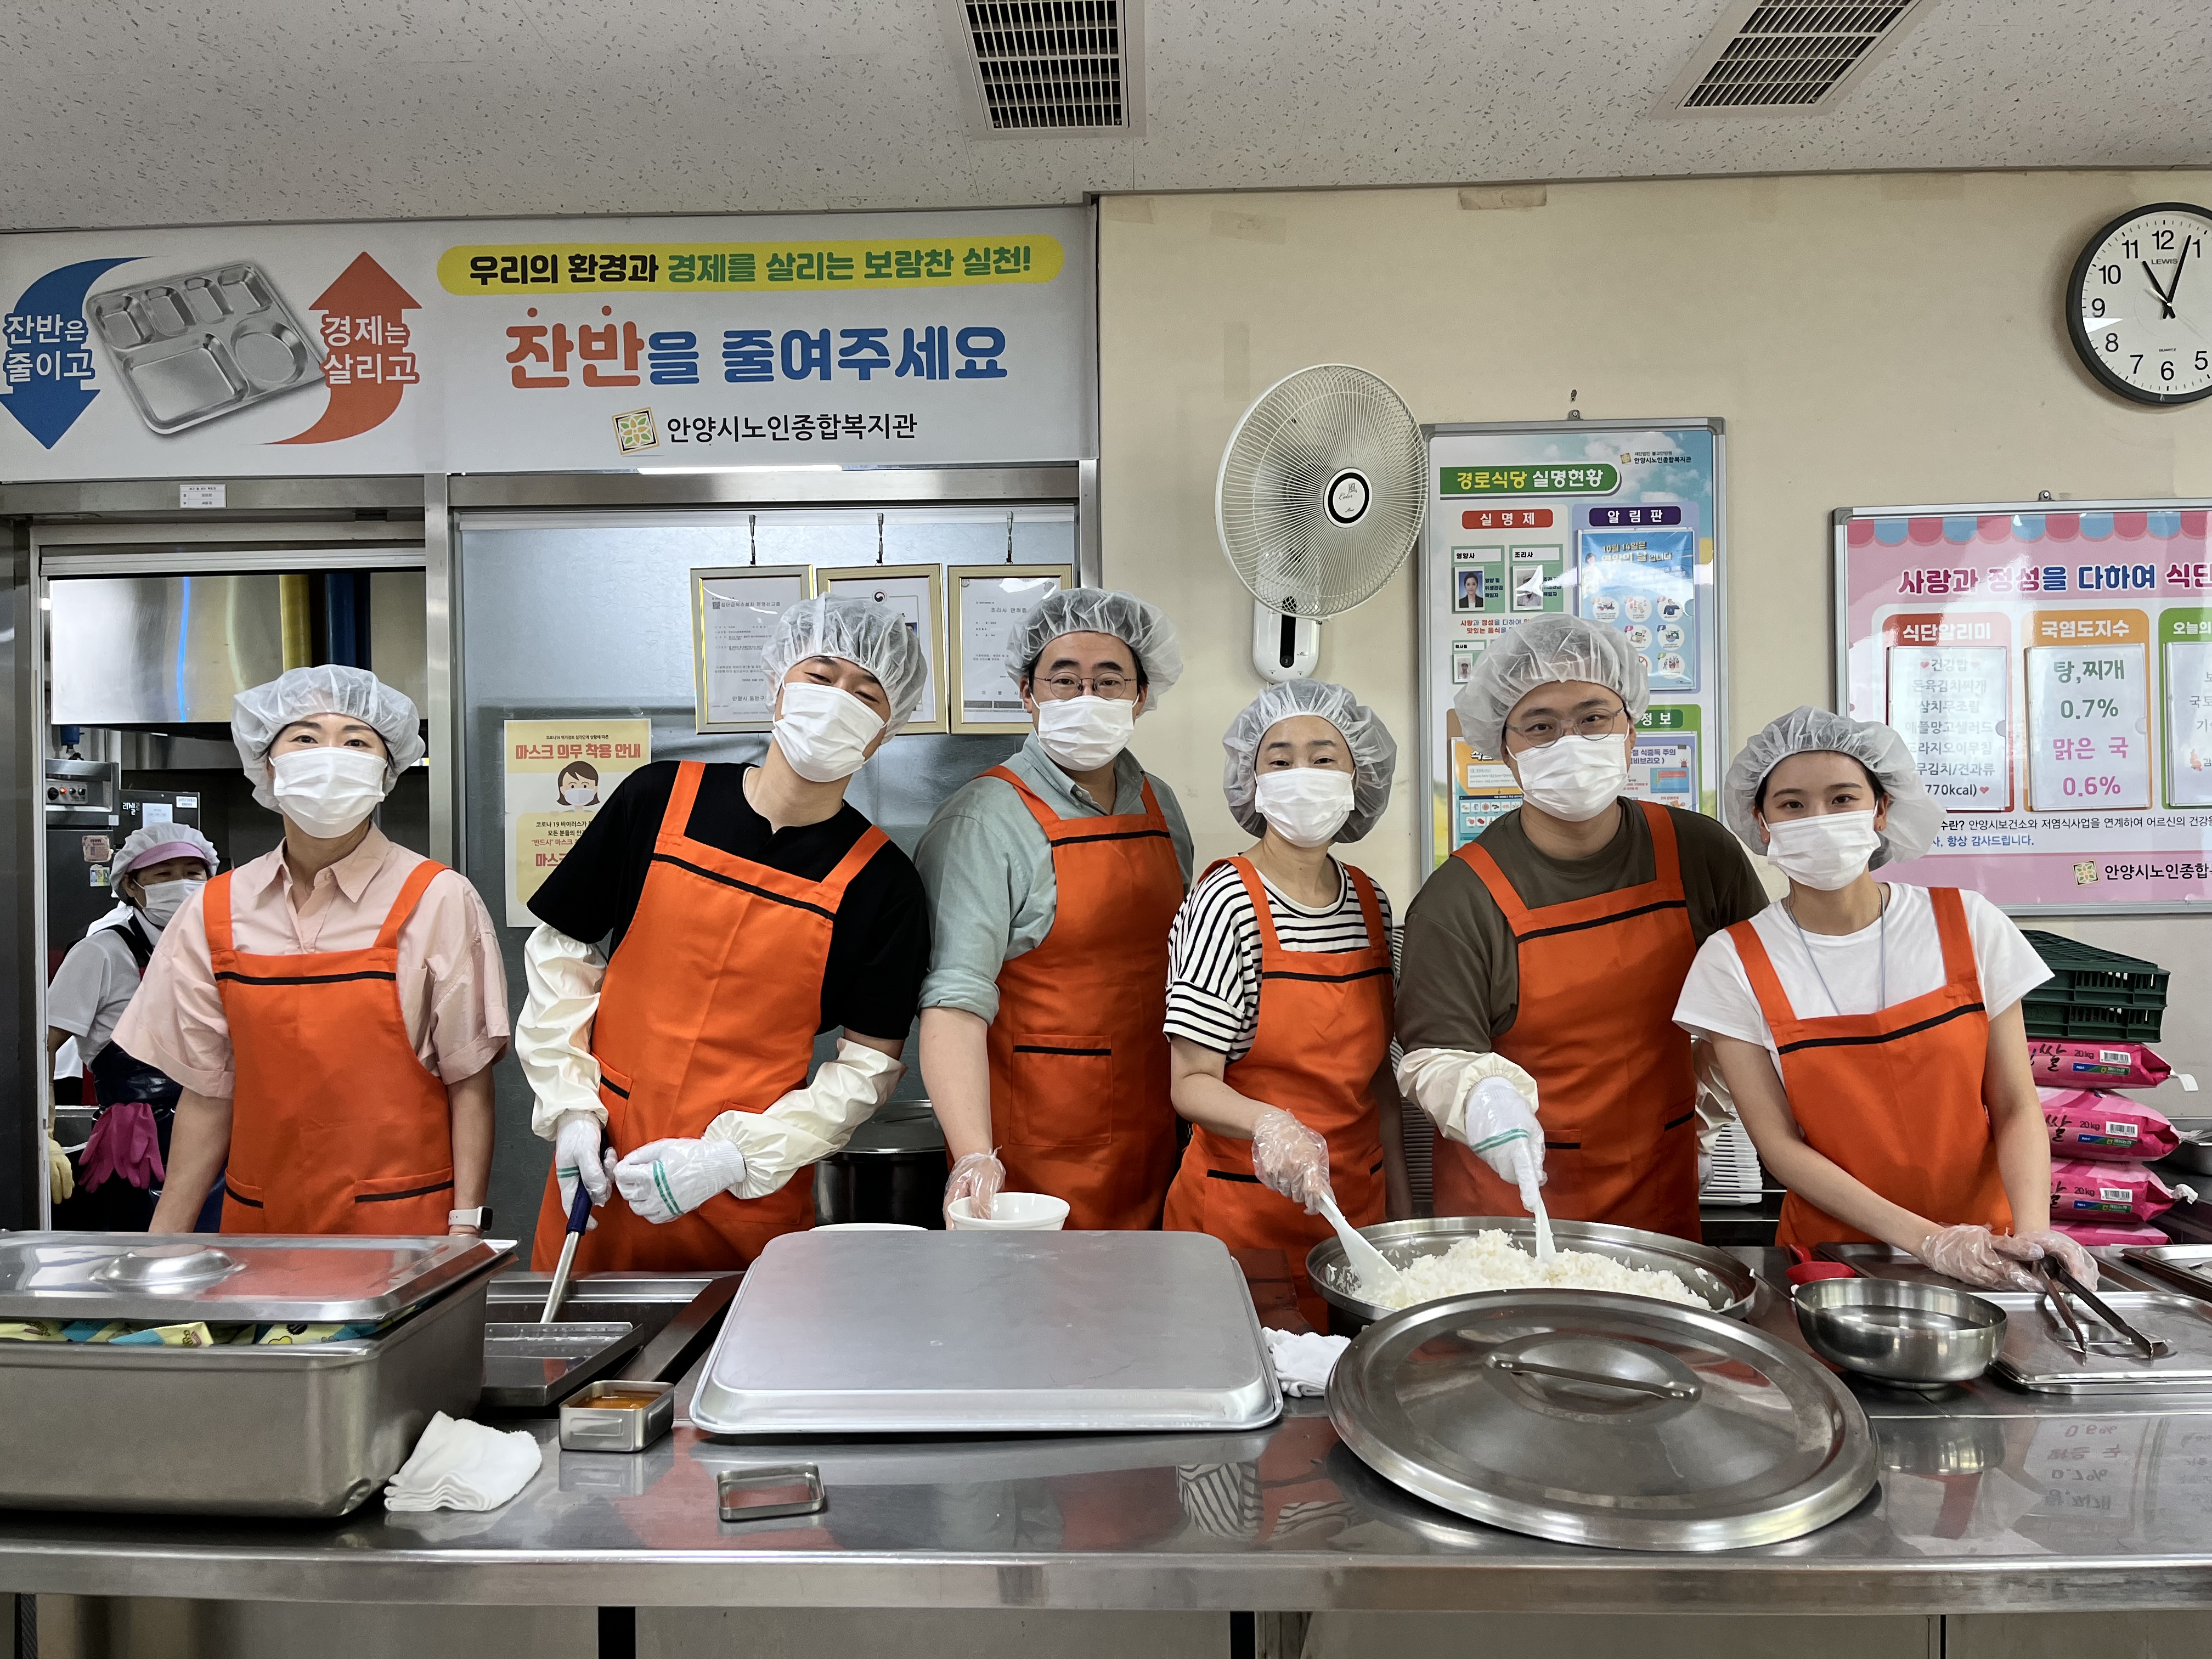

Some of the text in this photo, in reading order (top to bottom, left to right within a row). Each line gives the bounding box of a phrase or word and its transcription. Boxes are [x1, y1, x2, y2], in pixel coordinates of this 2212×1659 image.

[2122, 240, 2138, 258] 11
[2152, 230, 2174, 250] 12
[2192, 239, 2200, 258] 1
[469, 246, 1031, 285] 우리의 환경과 경제를 살리는 보람찬 실천!
[2099, 264, 2121, 284] 10
[2091, 298, 2105, 318] 9
[7, 314, 85, 343] 잔반은
[324, 315, 409, 346] 경제는
[2105, 333, 2119, 352] 8
[722, 325, 1008, 383] 줄여주세요
[2194, 351, 2208, 370] 5
[6, 352, 92, 381] 줄이고
[324, 354, 418, 383] 살리고
[2130, 354, 2143, 374] 7
[2161, 361, 2175, 380] 6
[667, 413, 917, 442] 안양시노인종합복지관
[1457, 469, 1604, 490] 경로식당 실명현황
[1602, 544, 1619, 552] 10월
[1898, 569, 1978, 594] 사랑과
[1989, 567, 2067, 591] 정성을
[2078, 564, 2155, 589] 다하여
[1903, 623, 1990, 641] 식단알리미
[2041, 620, 2129, 638] 국염도지수
[2173, 622, 2211, 635] 오늘의
[1932, 659, 1968, 672] 건강밥
[2053, 659, 2125, 684] 탕,찌개
[1912, 679, 1987, 692] 돈육김치찌개
[1918, 700, 1980, 713] 삼치무조림
[2061, 698, 2119, 720] 0.7%
[516, 743, 641, 759] 마스크 의무 착용 안내
[2053, 737, 2129, 760] 맑은 국
[1916, 763, 1995, 776] 무김치/견과류
[1925, 784, 1977, 797] 770kcal)
[2063, 776, 2121, 797] 0.6%
[1941, 820, 1965, 831] 수란?
[1969, 819, 2037, 831] 안양시보건소와
[2041, 817, 2100, 829] 저염식사업을
[2104, 817, 2142, 828] 연계하여
[2147, 816, 2185, 827] 어르신의
[1948, 836, 1967, 847] 항상
[1972, 835, 2034, 847] 감사드립니다.
